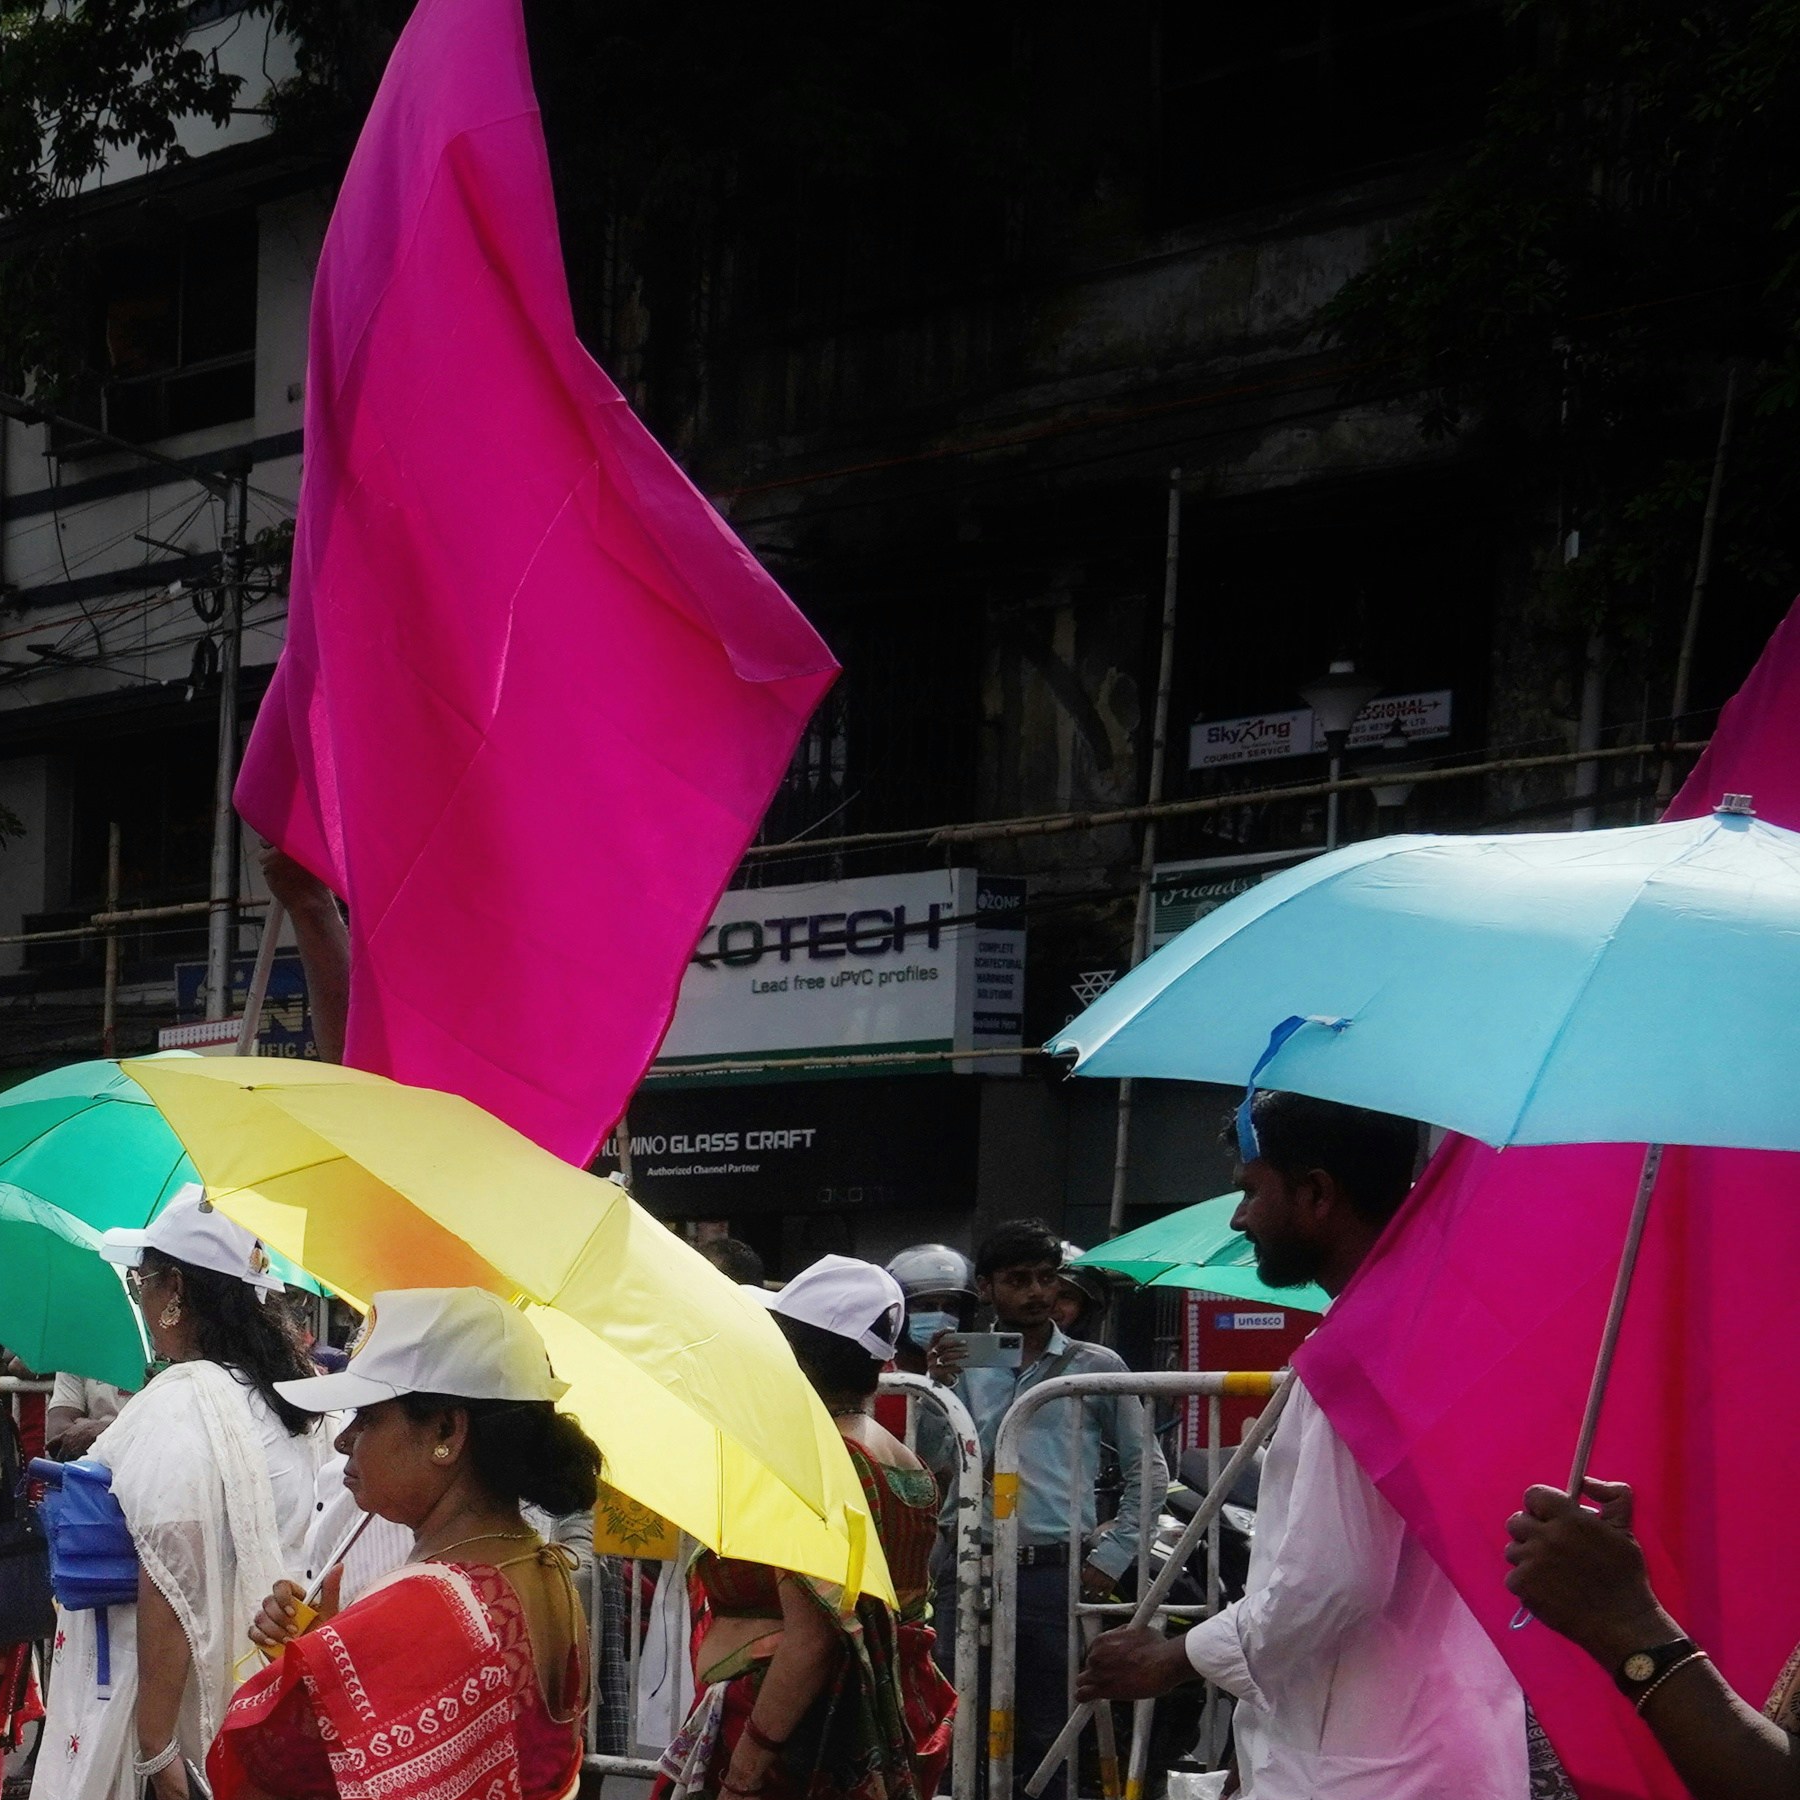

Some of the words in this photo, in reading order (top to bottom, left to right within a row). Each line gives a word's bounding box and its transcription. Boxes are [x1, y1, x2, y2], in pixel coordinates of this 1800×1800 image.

[1203, 751, 1243, 763] COURIER
[1247, 745, 1291, 758] SERVICE
[752, 977, 788, 995] Lead
[794, 973, 825, 991] free
[830, 969, 873, 988] uPVC
[878, 965, 939, 988] profiles
[669, 1131, 740, 1154] GLASS
[745, 1128, 816, 1151] CRAFT
[647, 1166, 691, 1178] Authorized
[693, 1164, 727, 1176] Channel
[728, 1163, 760, 1174] Partner
[1238, 1315, 1282, 1326] unesco
